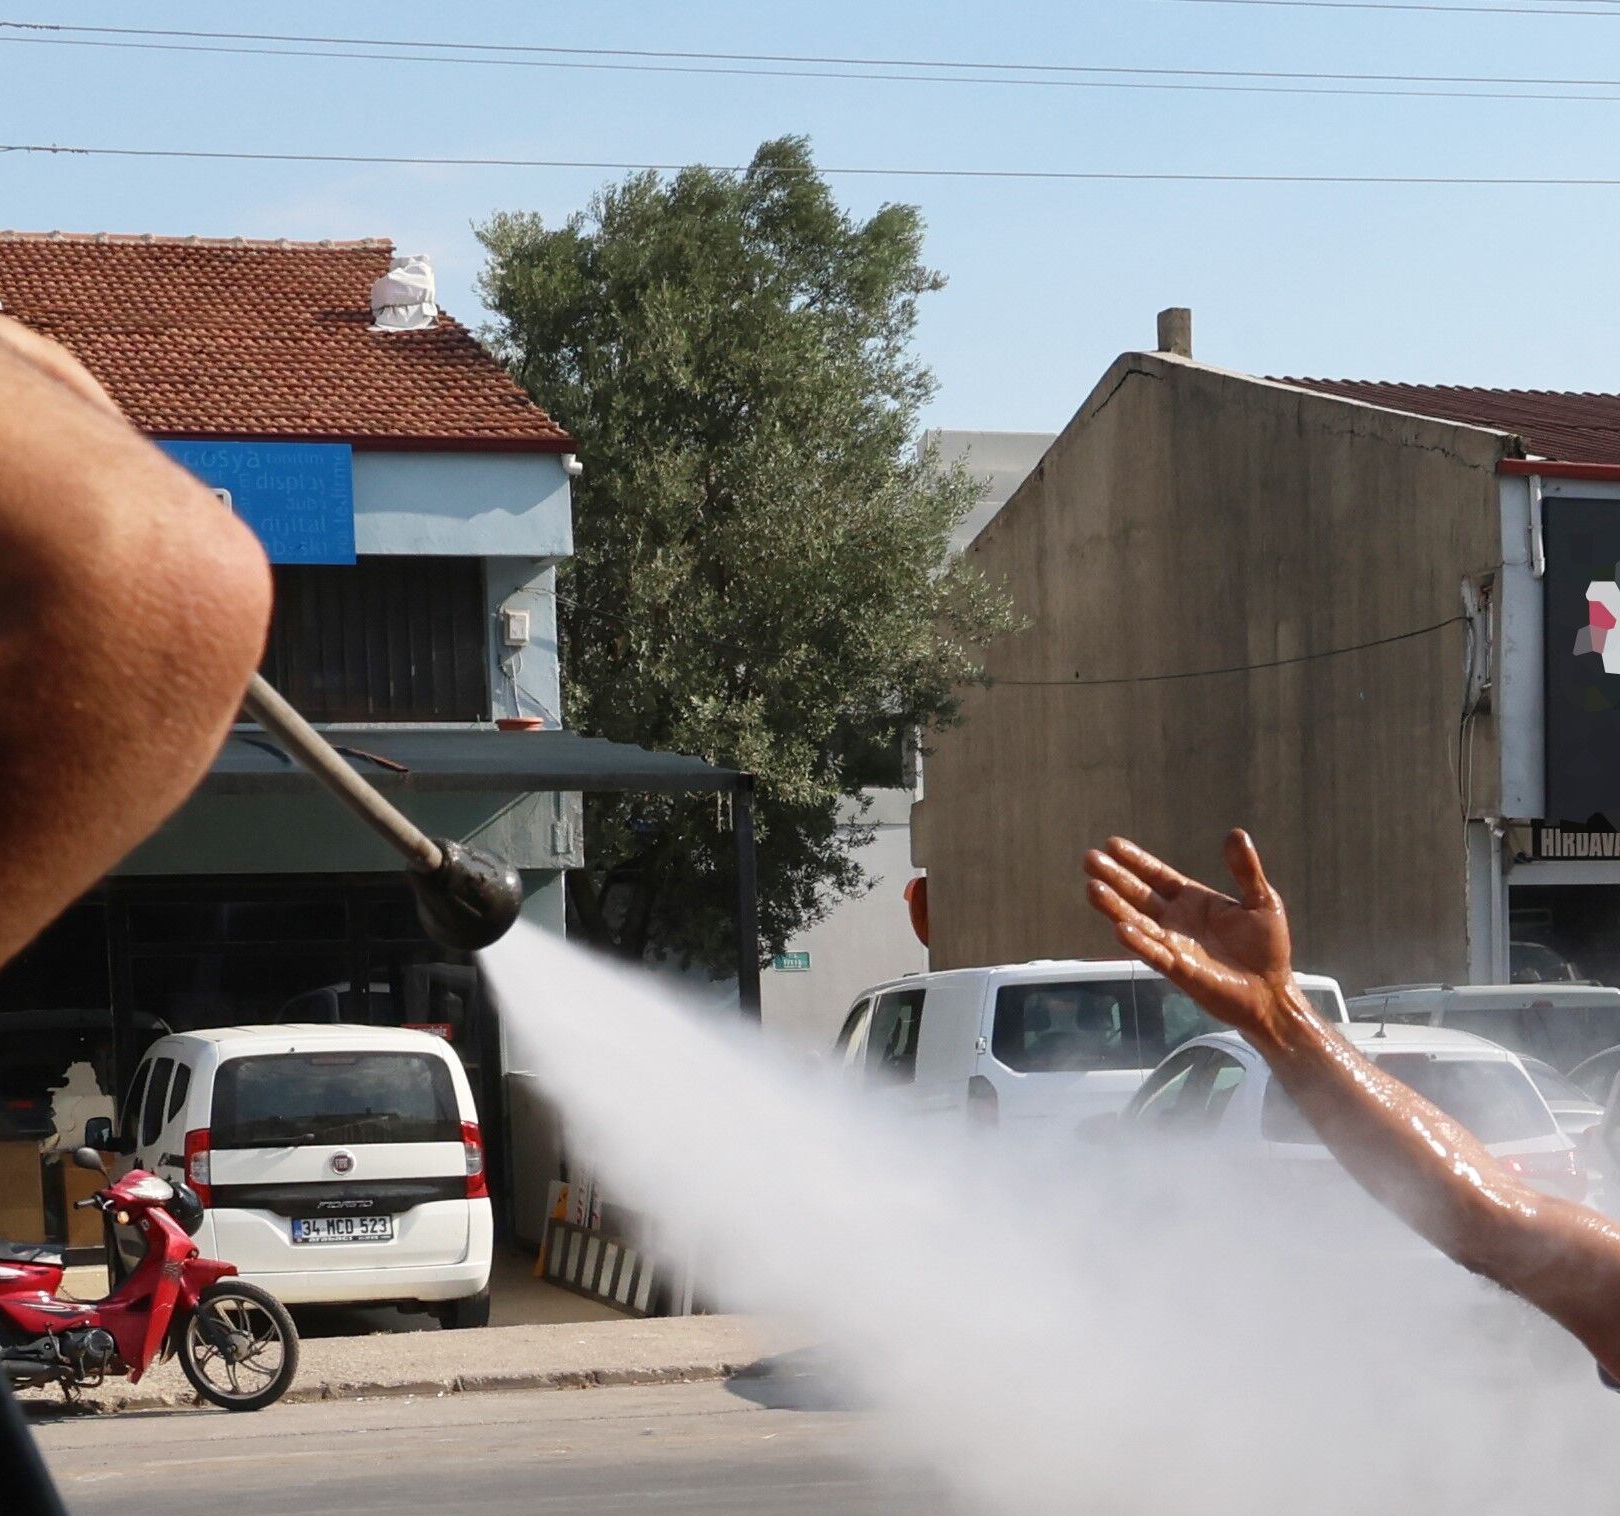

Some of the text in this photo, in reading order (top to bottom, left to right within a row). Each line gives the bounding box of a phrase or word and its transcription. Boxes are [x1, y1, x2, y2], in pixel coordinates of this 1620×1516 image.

[302, 1218, 388, 1236] 34 MCD 523
